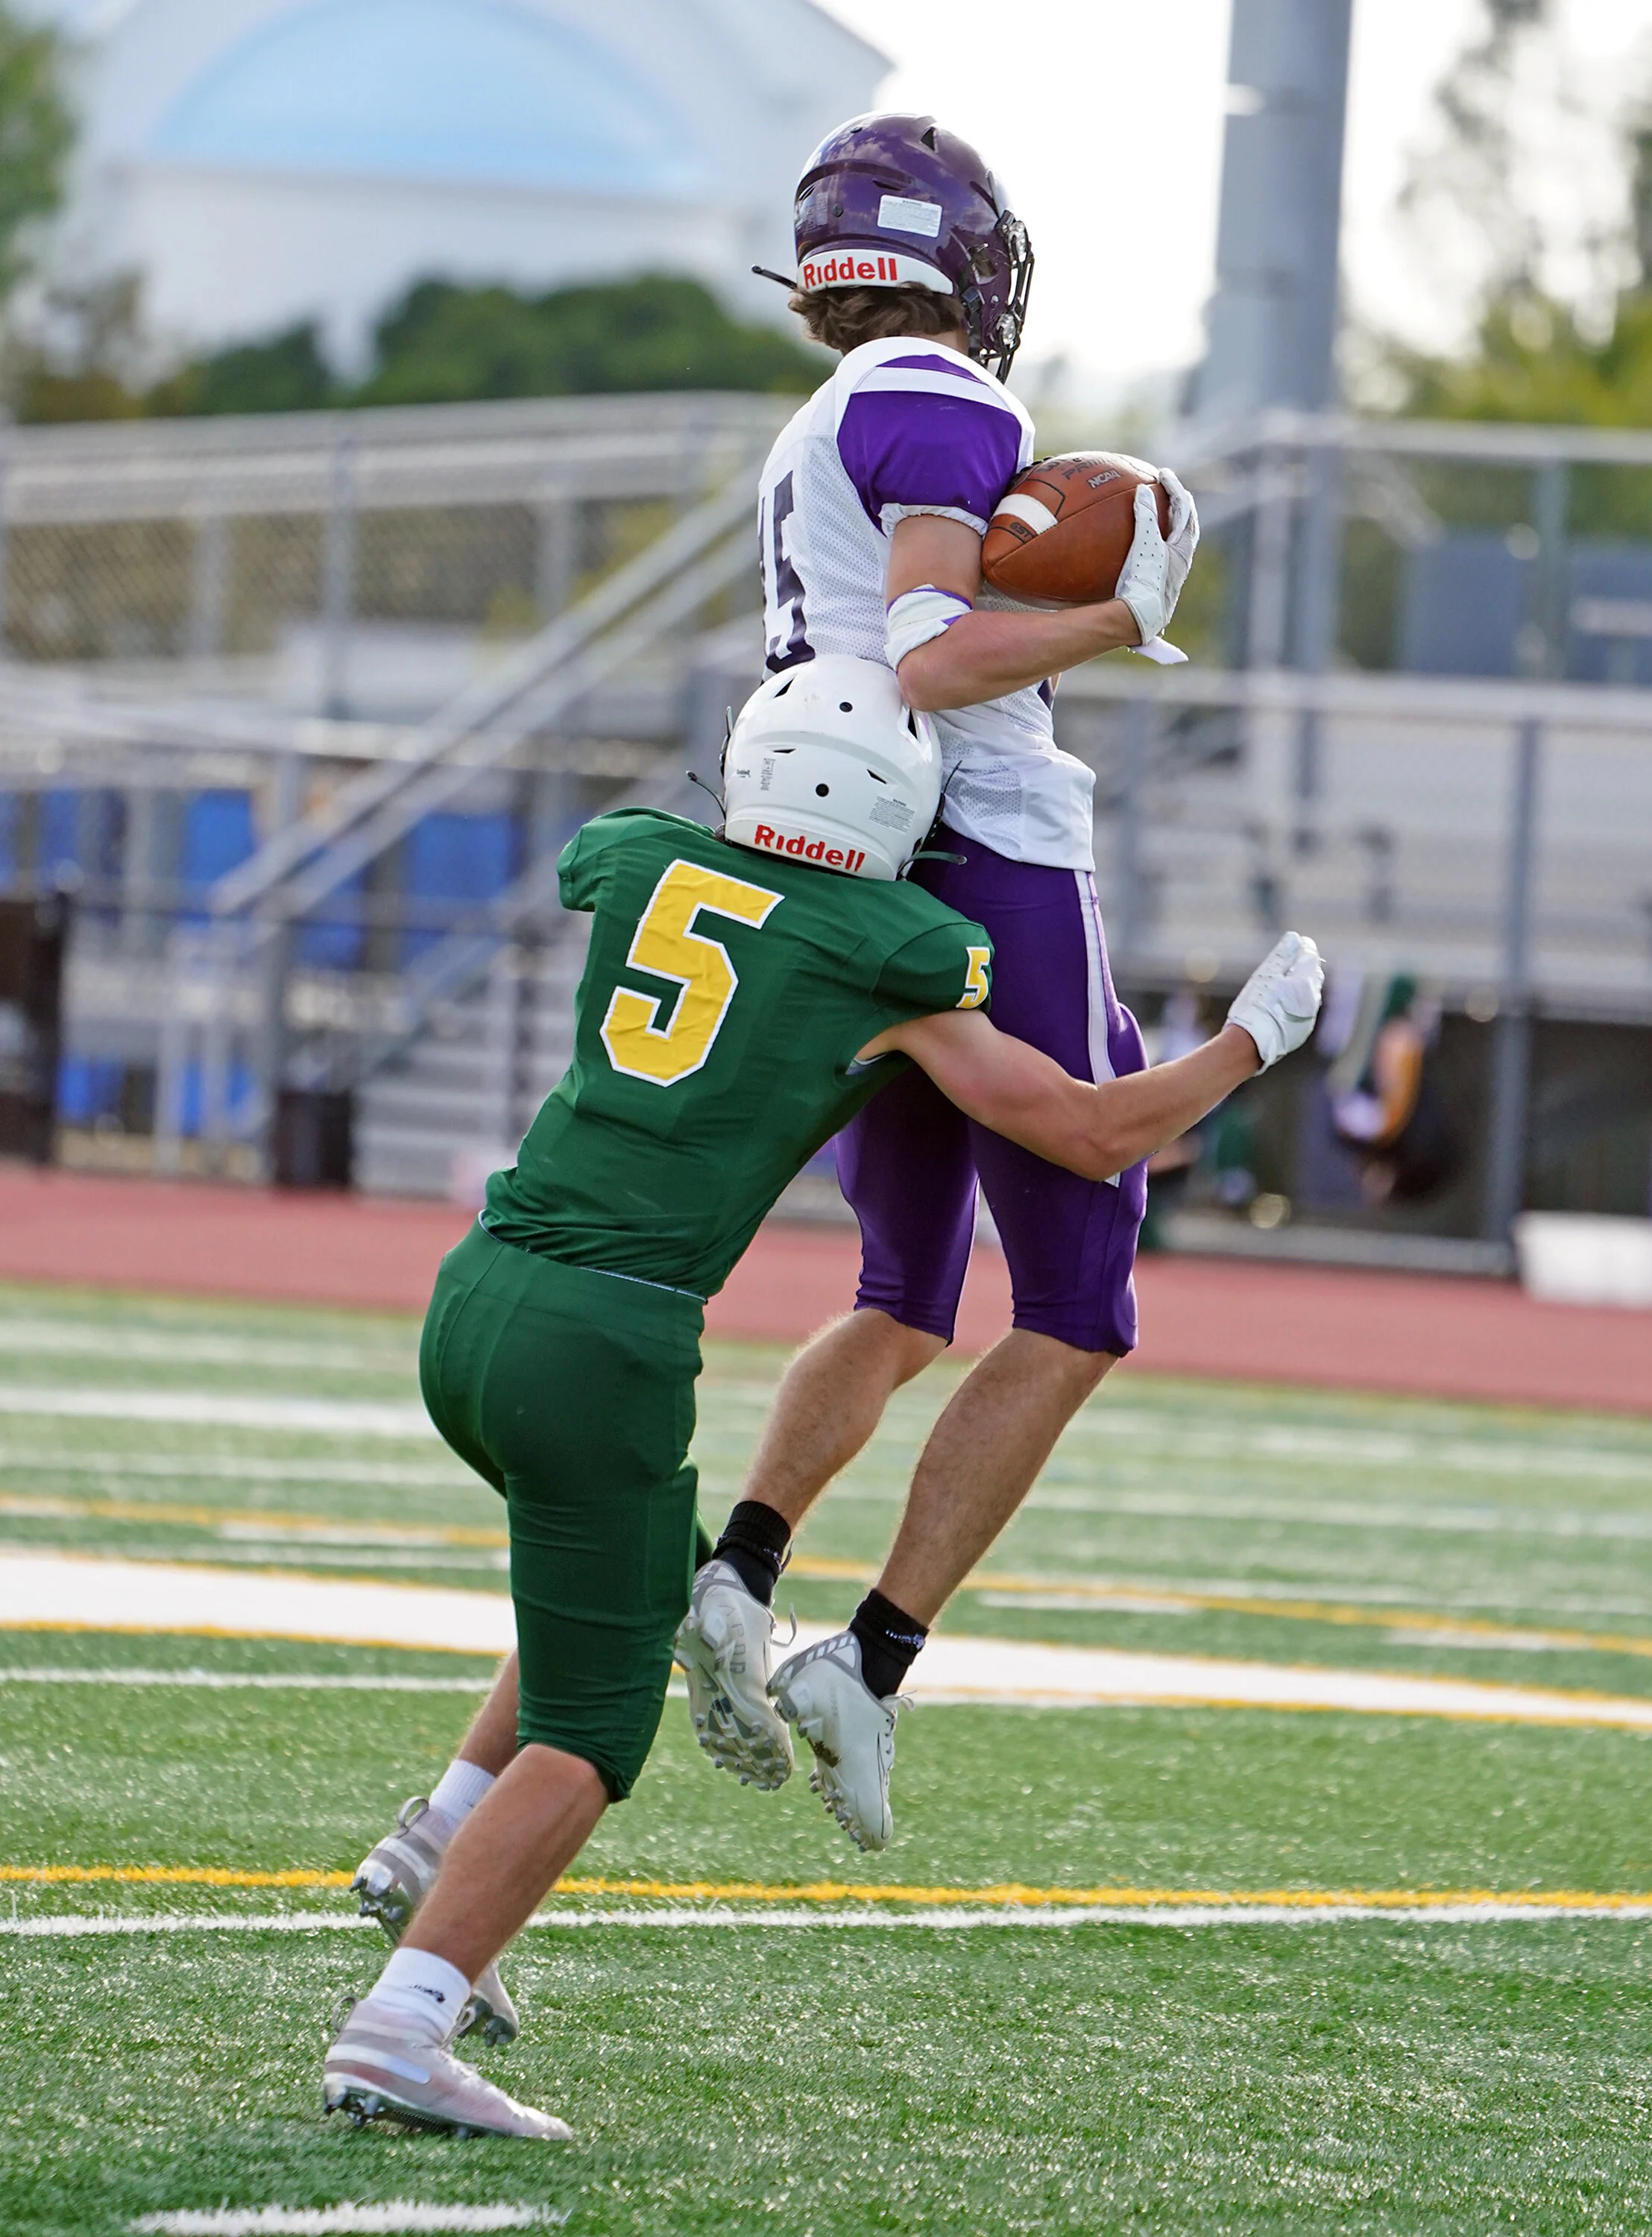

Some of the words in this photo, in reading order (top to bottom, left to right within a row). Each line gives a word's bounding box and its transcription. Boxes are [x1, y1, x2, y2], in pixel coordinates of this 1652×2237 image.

[804, 257, 898, 289] Riddell
[1087, 468, 1121, 489] NCAA
[754, 824, 866, 872] Riddell
[599, 858, 786, 1088] 5
[955, 946, 991, 1010] 5
